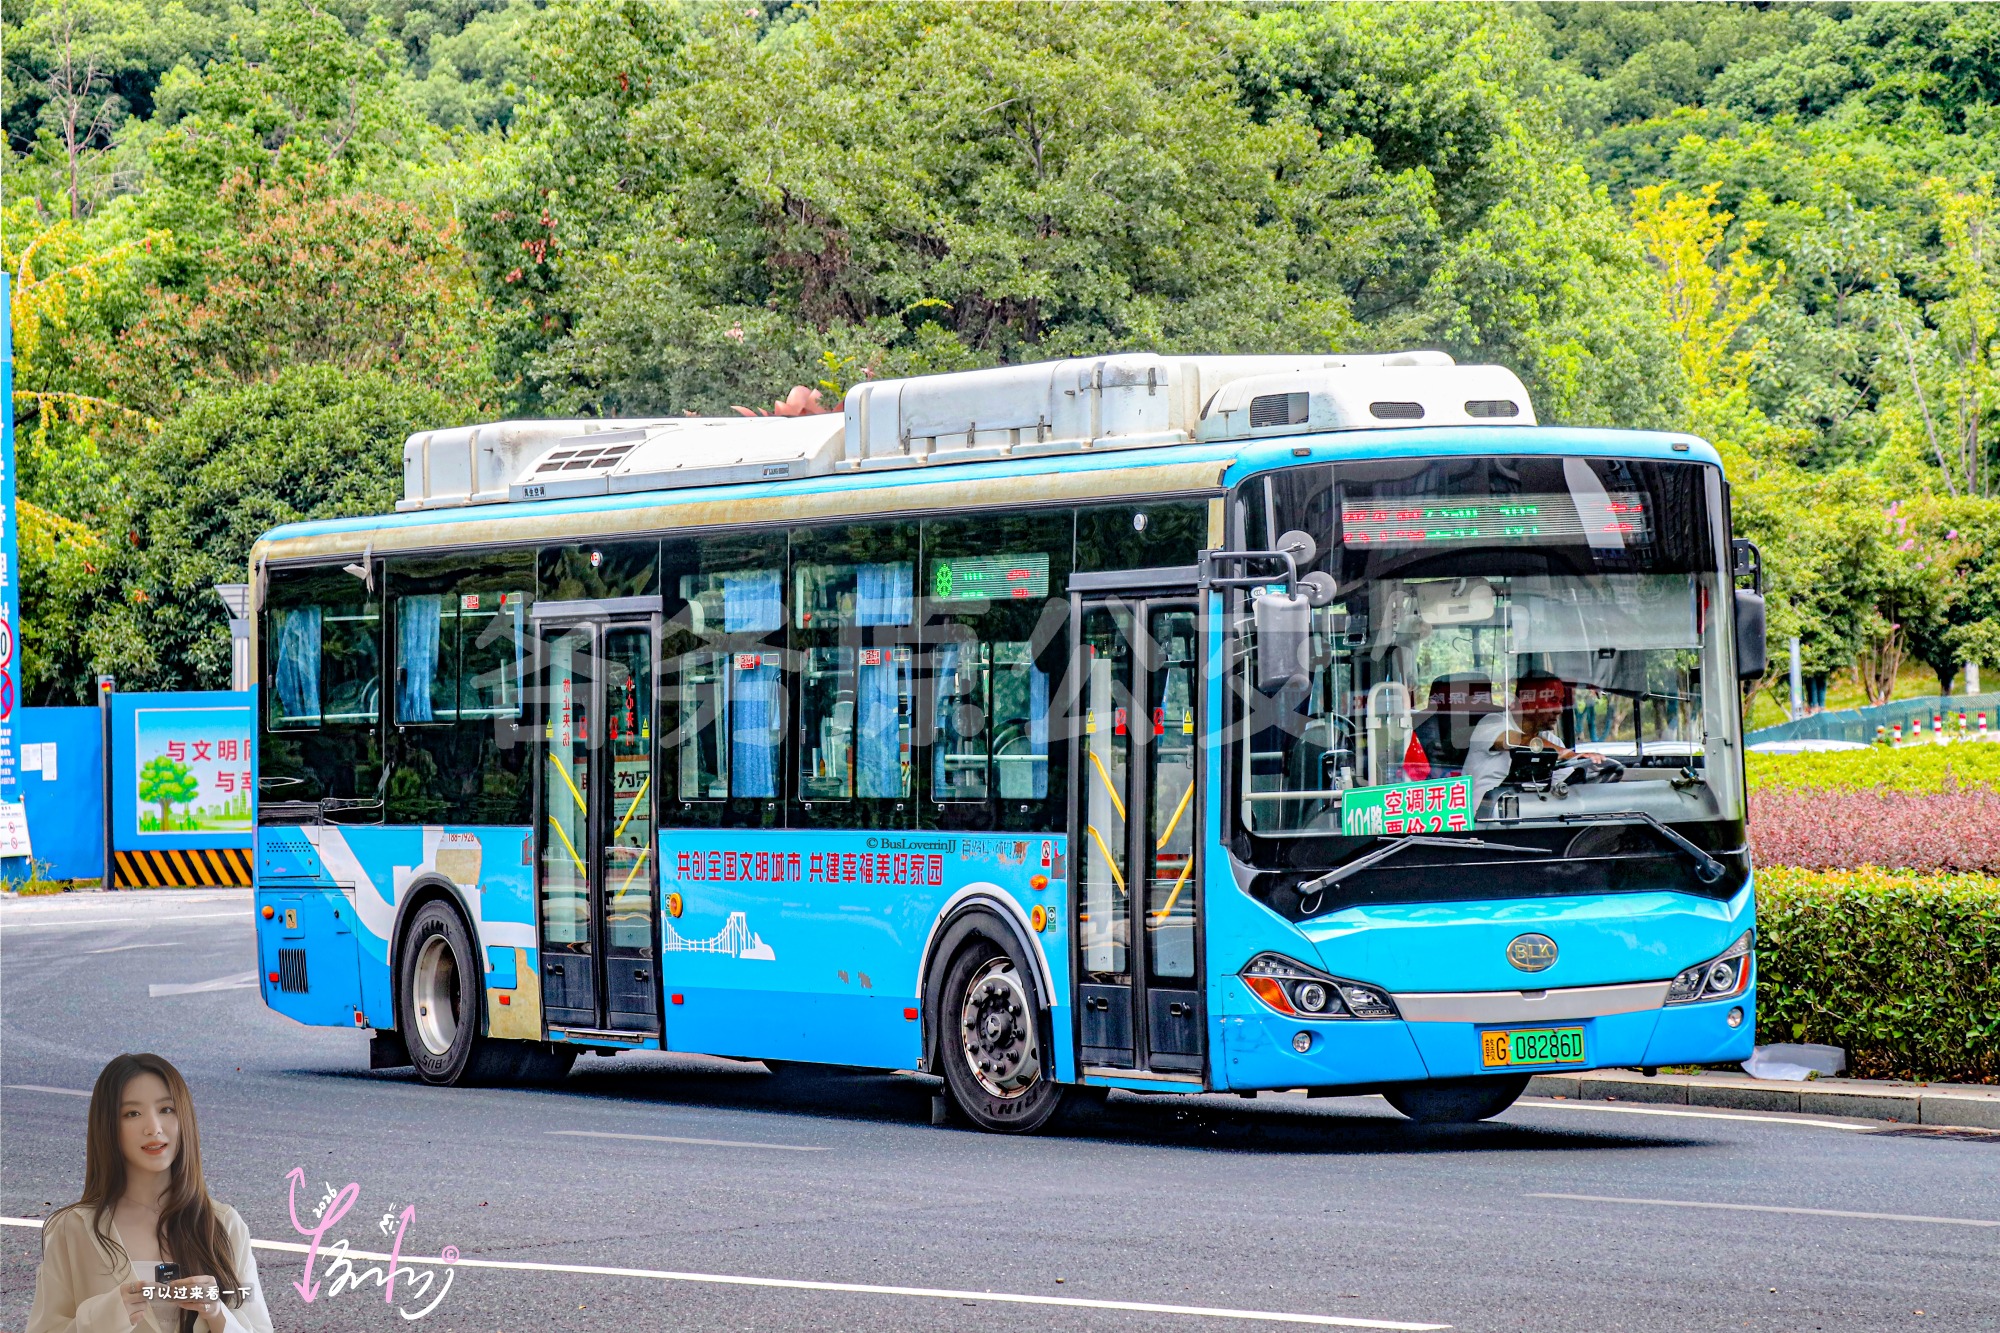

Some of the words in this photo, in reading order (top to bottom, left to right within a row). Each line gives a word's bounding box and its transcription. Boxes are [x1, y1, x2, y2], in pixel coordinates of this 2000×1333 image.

[1384, 783, 1467, 816] 空调开启
[677, 850, 801, 882] 共创全国文明城市
[809, 852, 943, 886] 共建幸福美好家园
[1515, 943, 1551, 959] BLK
